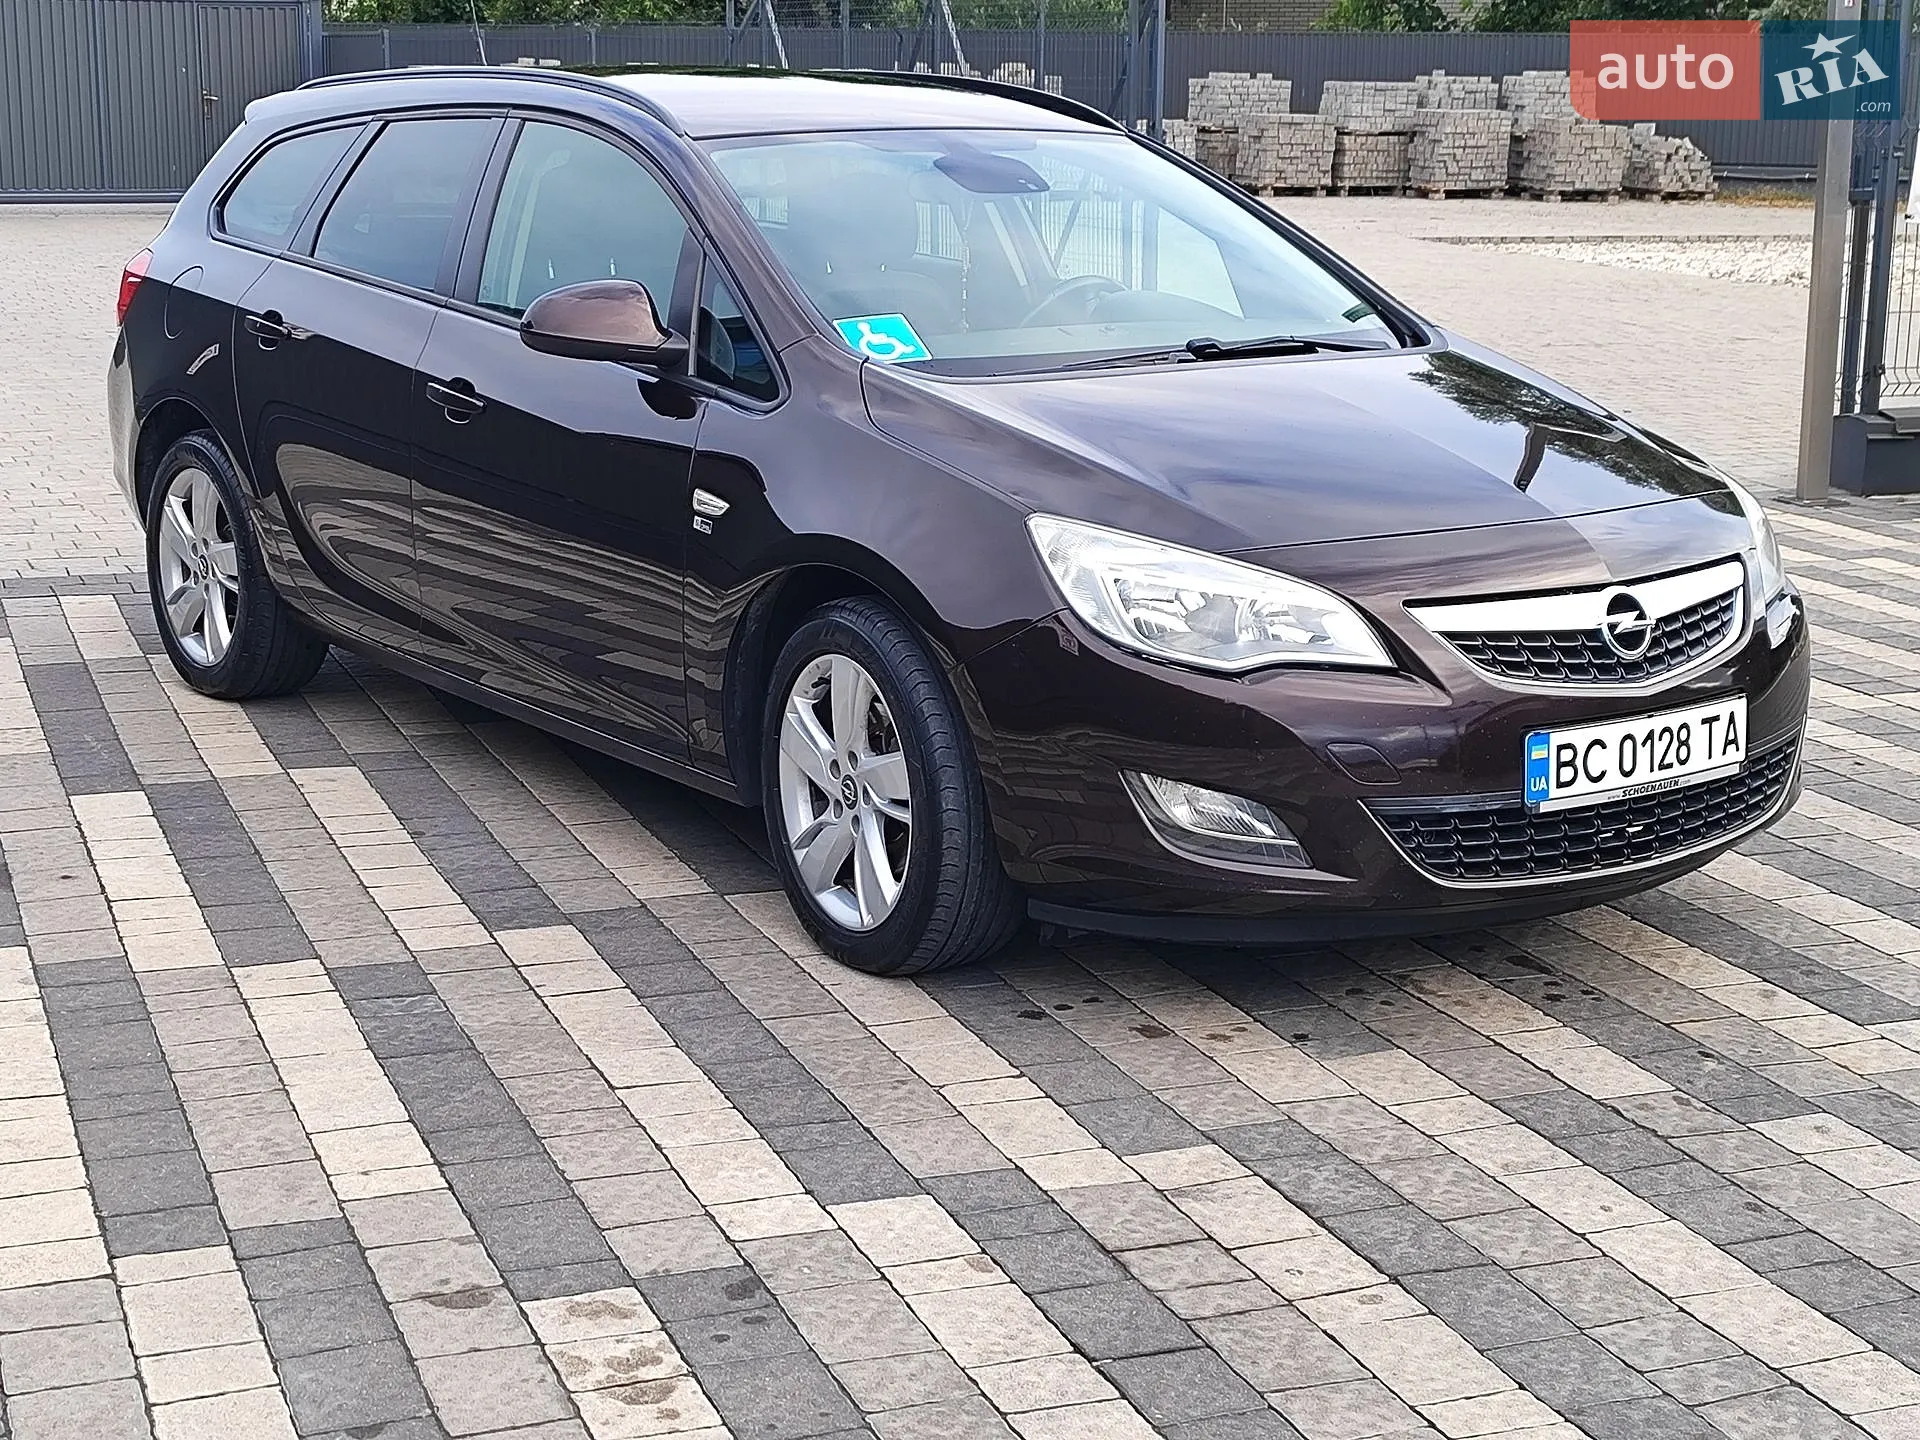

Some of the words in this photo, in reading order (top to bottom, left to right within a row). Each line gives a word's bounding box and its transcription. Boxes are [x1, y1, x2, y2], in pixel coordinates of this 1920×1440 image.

[1556, 739, 1607, 789] BC
[1619, 722, 1691, 778] 0128
[1701, 710, 1740, 760] TA
[1530, 775, 1548, 792] UA
